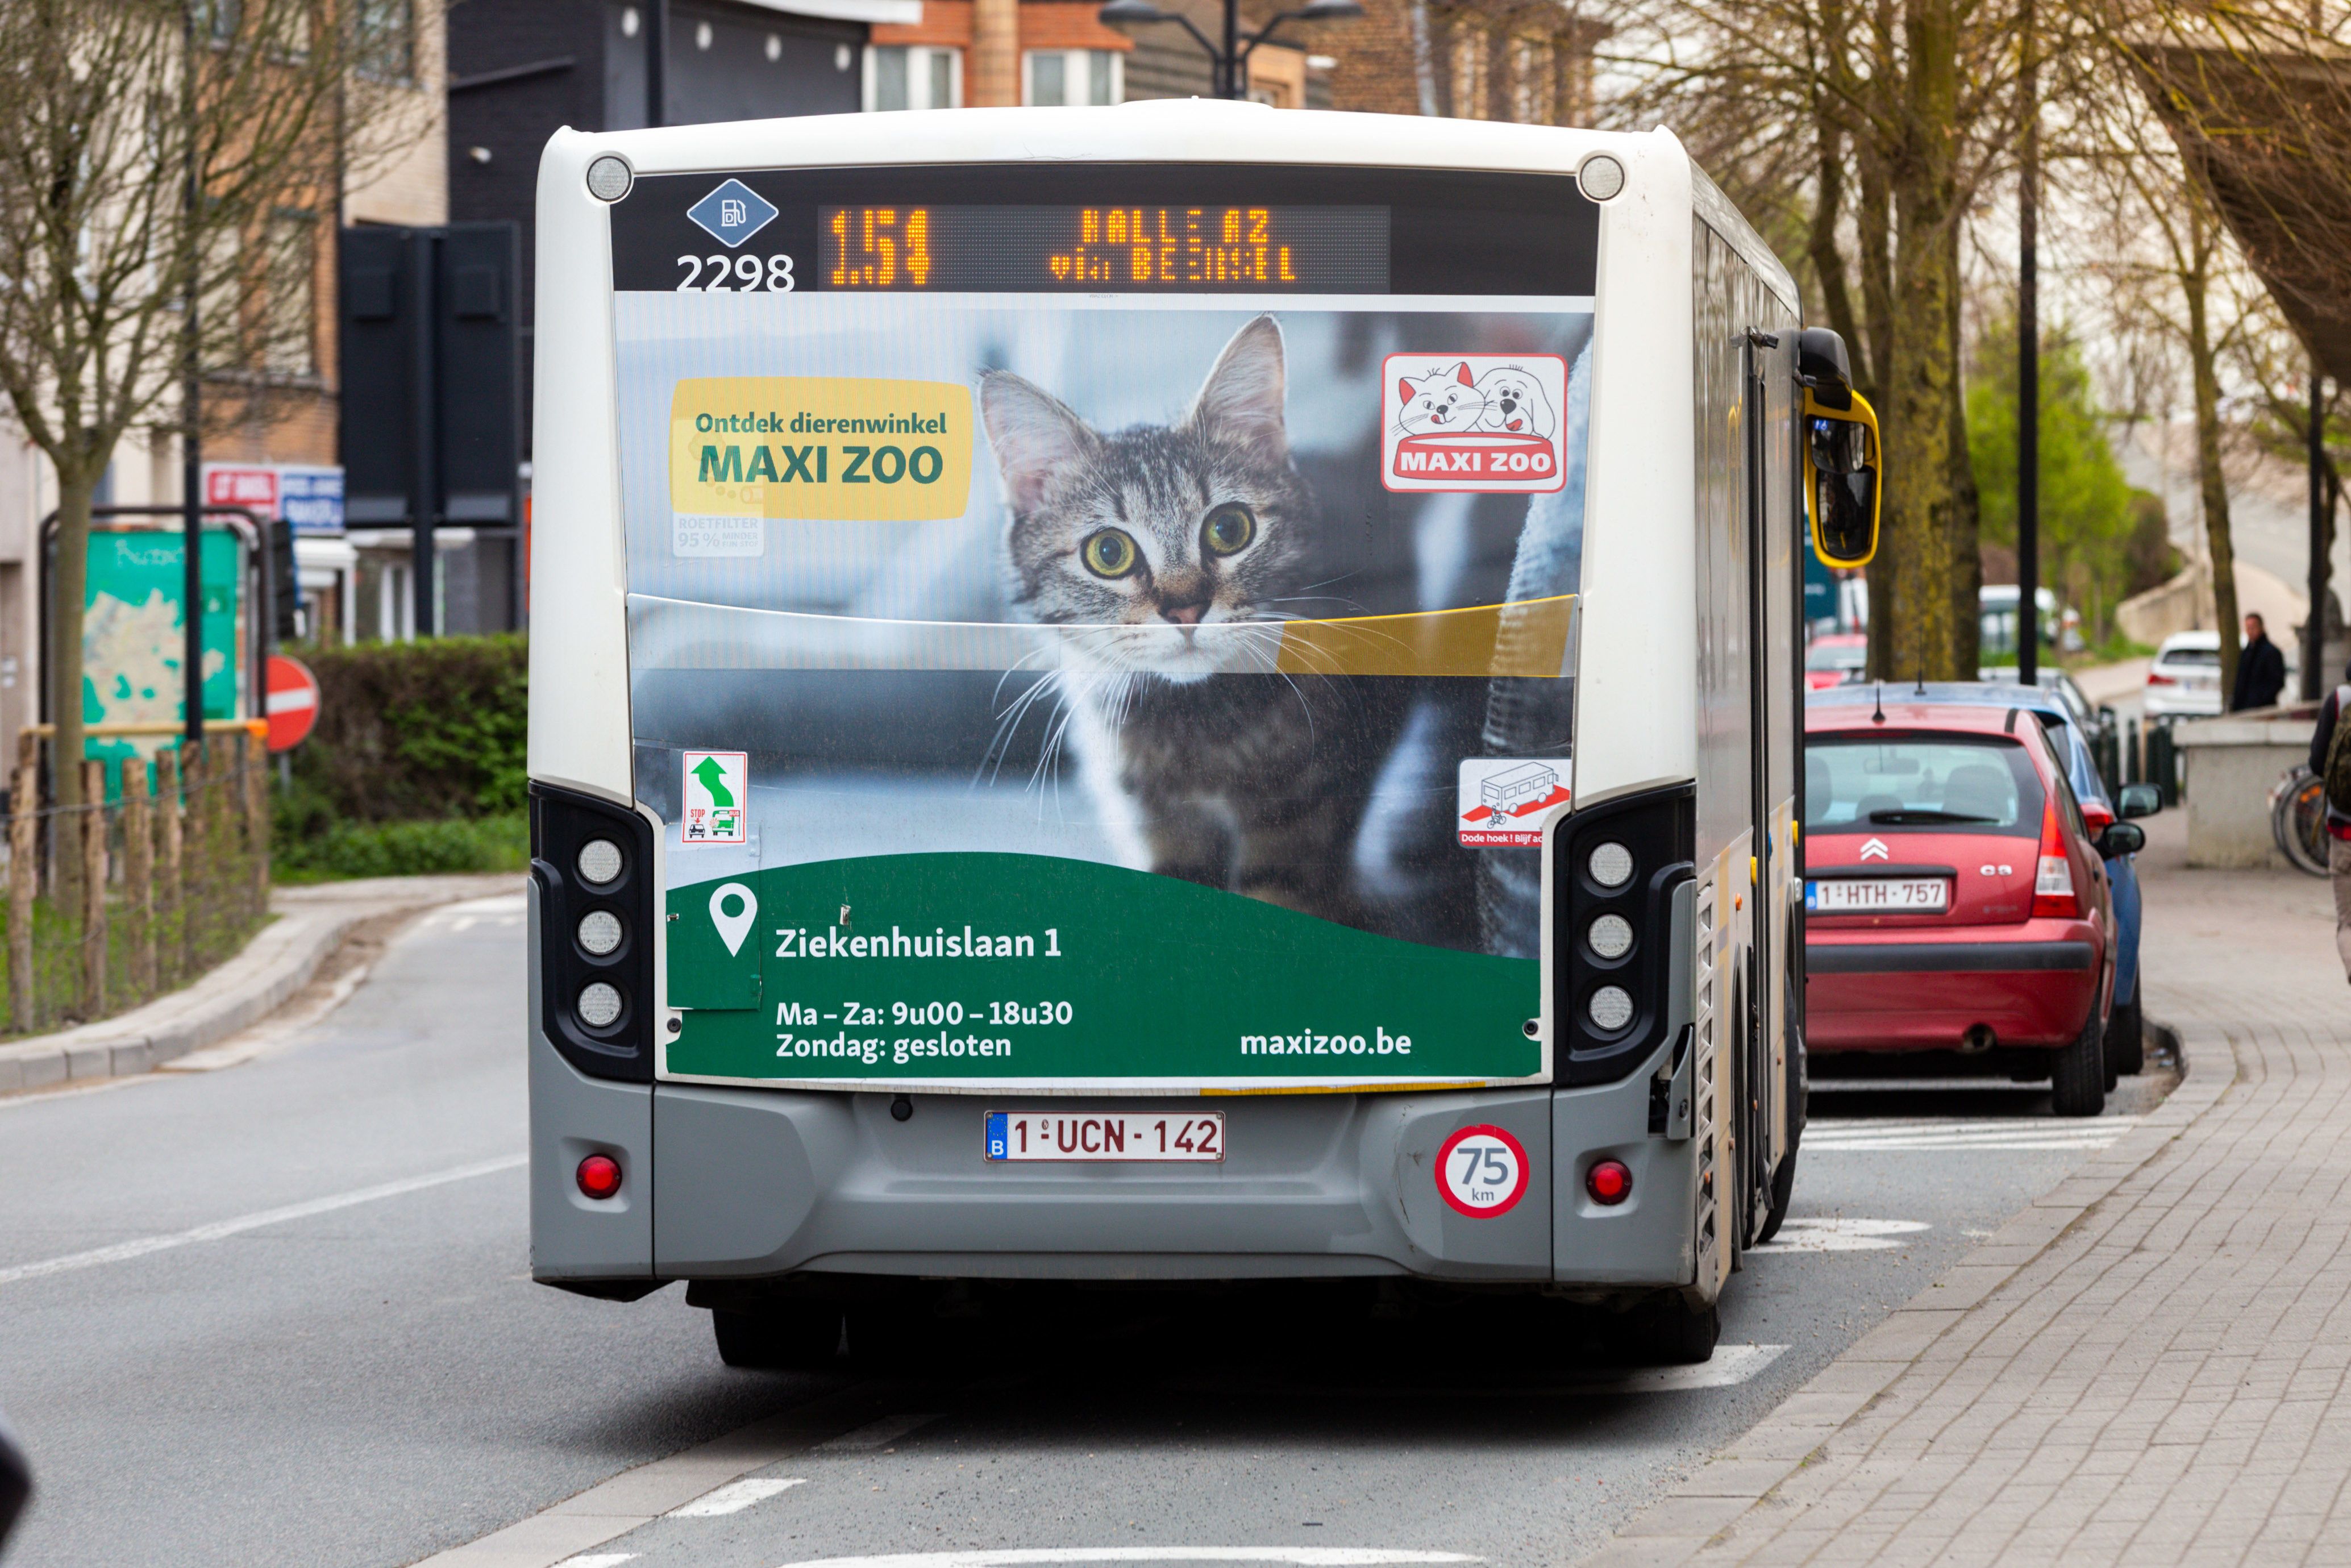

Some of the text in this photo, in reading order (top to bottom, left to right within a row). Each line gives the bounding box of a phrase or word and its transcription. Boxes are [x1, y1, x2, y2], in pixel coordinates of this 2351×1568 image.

[1224, 209, 1268, 243] AZ
[676, 254, 794, 292] 2298
[696, 412, 947, 434] Ontdek dierenwinkel
[698, 445, 943, 484] MAXI ZOO
[1401, 452, 1551, 472] MAXI ZOO
[679, 518, 758, 529] ROETFILTER
[678, 533, 699, 547] 95
[690, 809, 705, 818] STOP
[1461, 834, 1484, 842] Dode
[1487, 834, 1509, 842] hoek
[1514, 834, 1532, 845] Blijf
[1822, 884, 1942, 905] 1-HTH-757
[776, 926, 1062, 958] Ziekenhuislaan 1
[776, 1002, 817, 1026] Ma
[843, 1002, 884, 1025] Za:
[892, 1001, 963, 1025] 9u00
[989, 1001, 1073, 1025] 18u30
[776, 1031, 1011, 1064] Zondag: gesloten
[1241, 1026, 1412, 1055] maxizoo.be
[991, 1140, 1004, 1155] B
[1015, 1120, 1218, 1153] 1-UCN-142
[1459, 1147, 1509, 1186] 75
[1472, 1188, 1494, 1201] km
